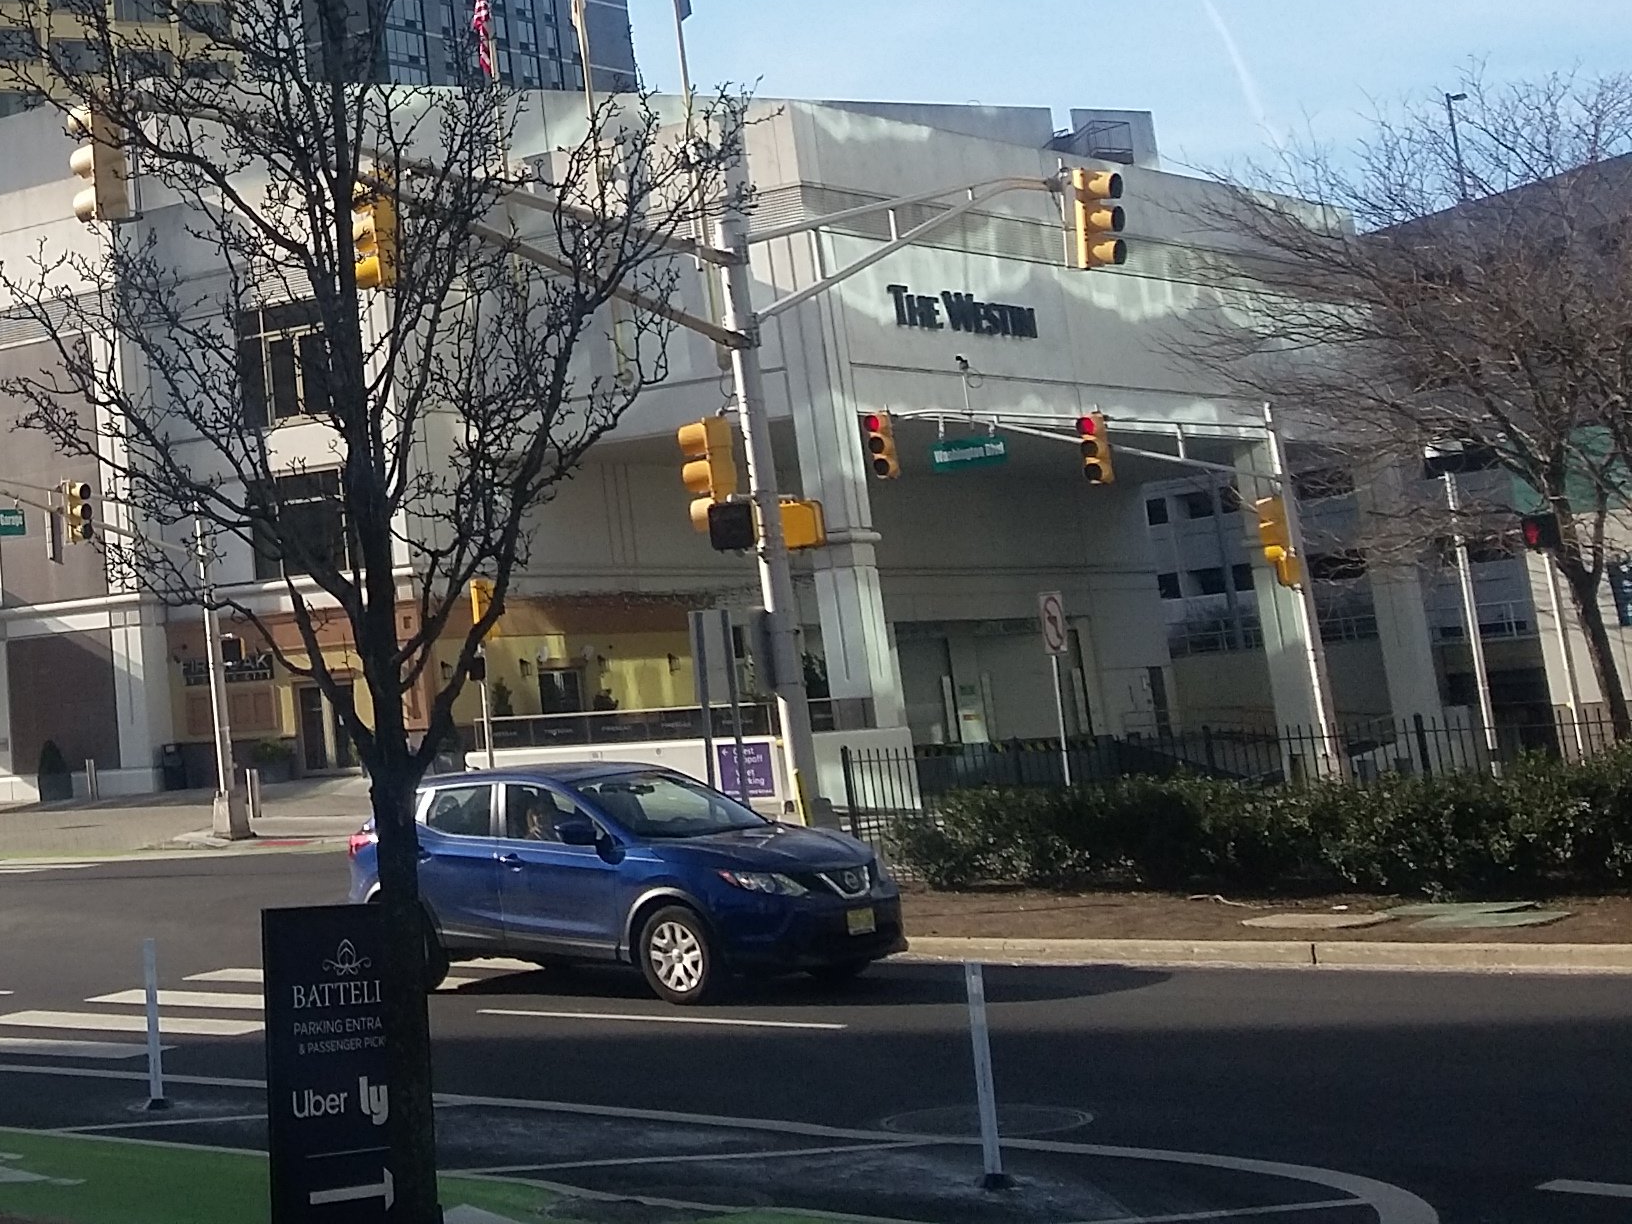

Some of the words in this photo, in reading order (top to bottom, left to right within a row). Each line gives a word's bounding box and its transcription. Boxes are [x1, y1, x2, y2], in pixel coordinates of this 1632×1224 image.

[887, 284, 944, 330] THE
[941, 290, 1038, 339] WESTIN
[933, 447, 985, 464] Washington
[984, 441, 1005, 456] Blvd
[0, 513, 24, 527] Garage
[293, 1019, 343, 1036] PARKING
[345, 1016, 383, 1032] ENTRA
[307, 1037, 362, 1054] PASSENGER
[292, 1089, 348, 1119] Uber
